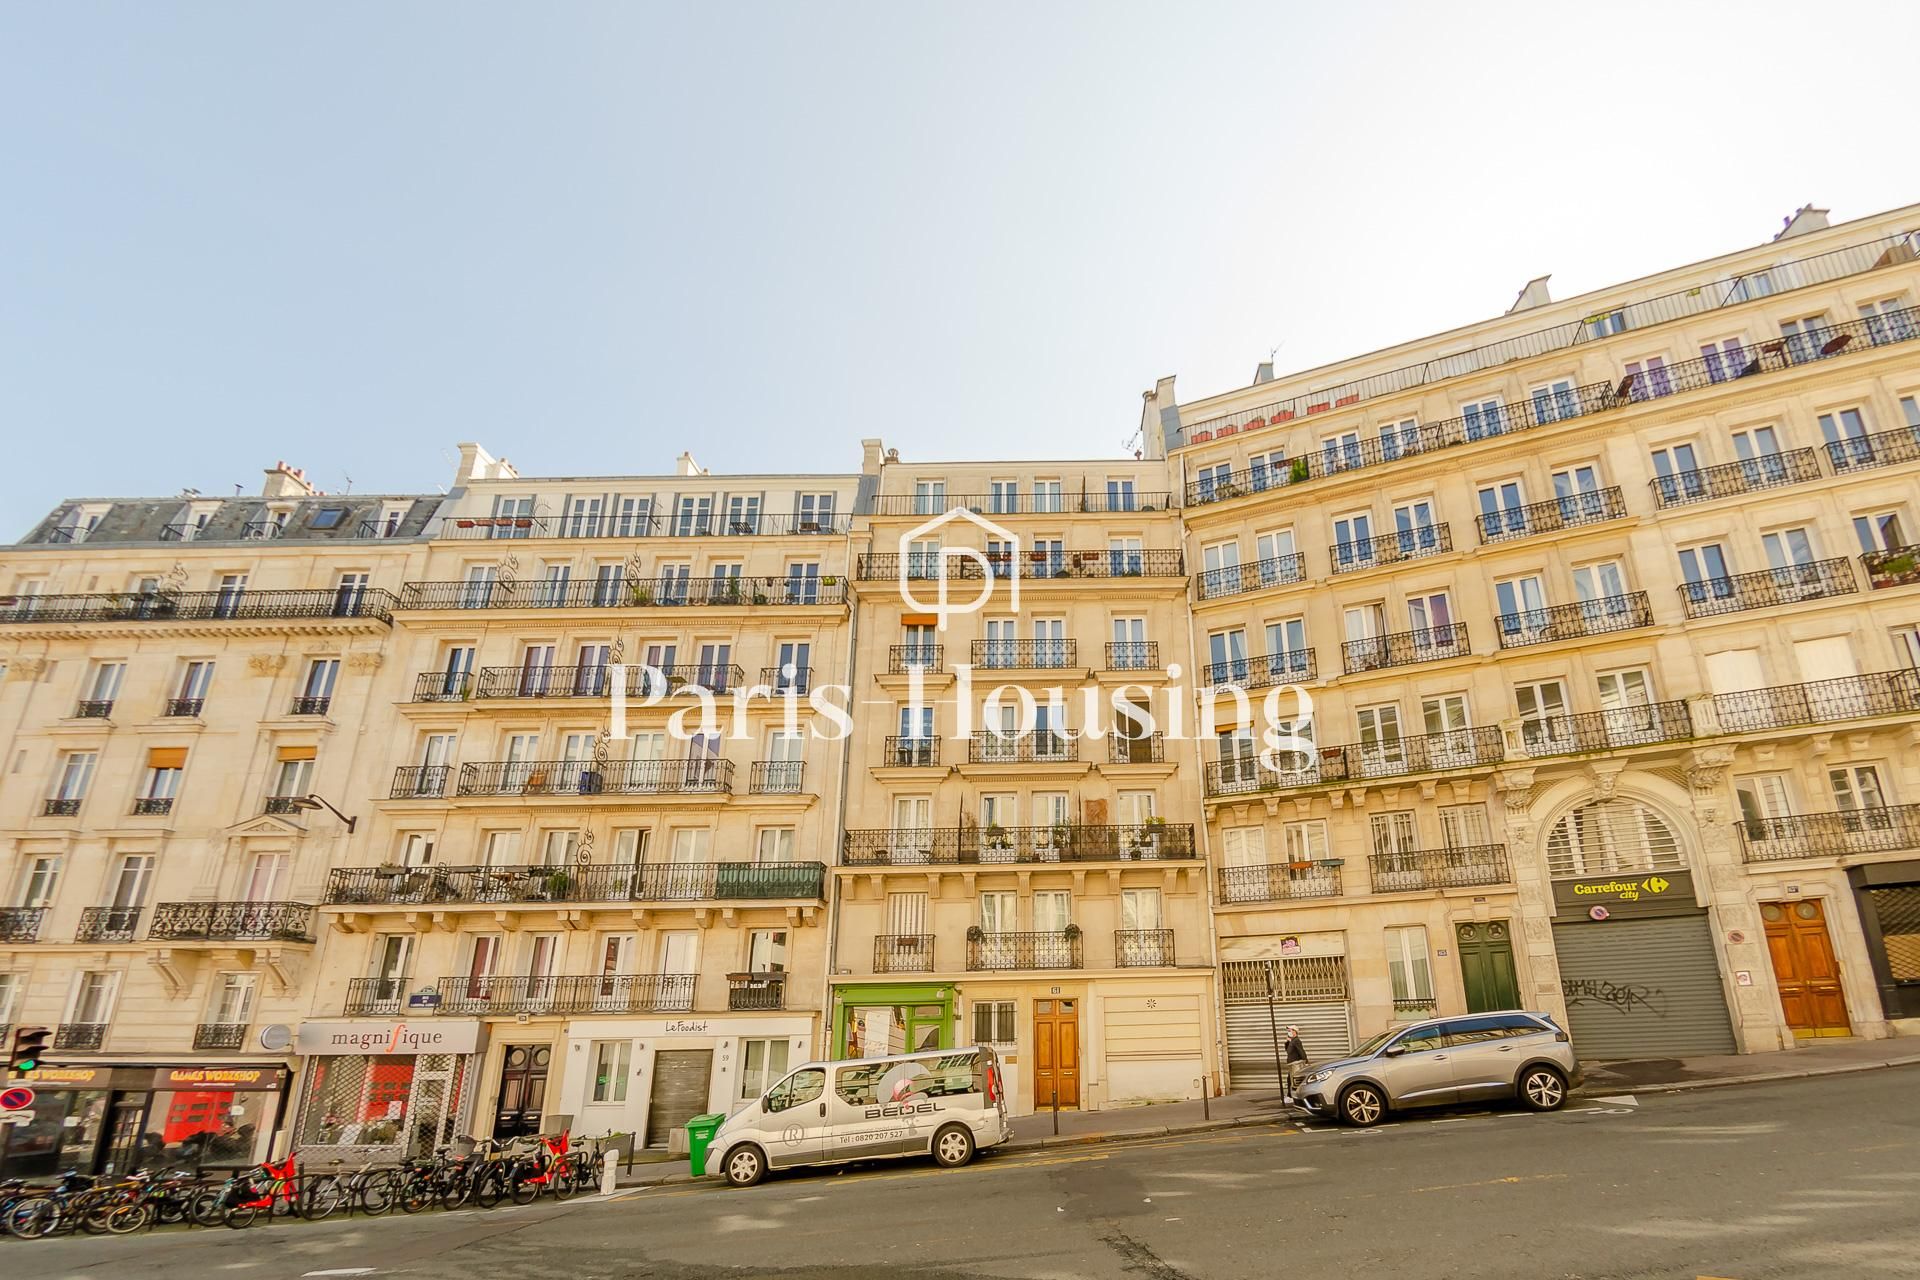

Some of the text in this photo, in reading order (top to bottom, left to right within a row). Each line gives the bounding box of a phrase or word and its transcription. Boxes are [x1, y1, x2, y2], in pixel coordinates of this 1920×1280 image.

[1574, 881, 1638, 895] Carrefour
[1619, 891, 1639, 901] city
[331, 1024, 443, 1054] magnifique
[170, 1070, 261, 1083] GAMES WORKSHOP
[865, 1103, 945, 1119] BEDEL
[855, 1134, 873, 1142] 0820
[874, 1132, 888, 1140] 207
